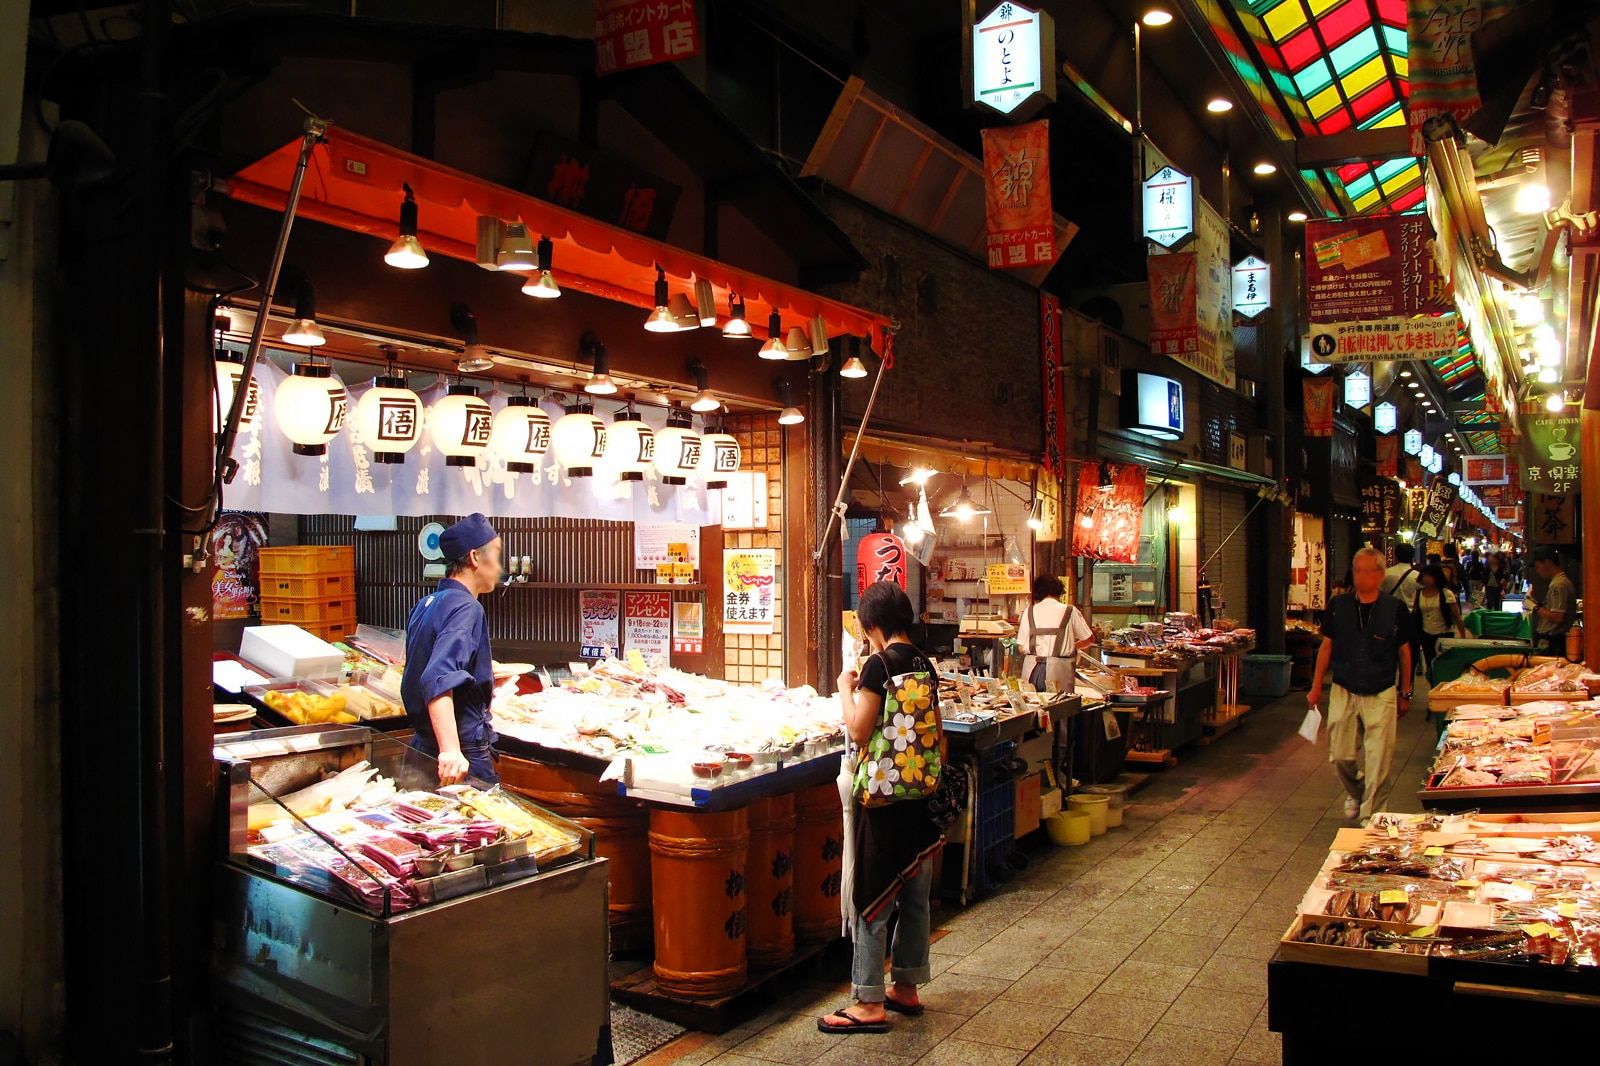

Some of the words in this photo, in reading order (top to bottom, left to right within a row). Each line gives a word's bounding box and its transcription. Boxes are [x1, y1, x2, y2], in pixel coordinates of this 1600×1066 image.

[998, 29, 1014, 85] のとよ
[1410, 221, 1425, 309] ポイントカード
[1337, 328, 1457, 354] 自転車は押して歩きましょう
[1553, 482, 1571, 493] 2F
[628, 594, 669, 604] マンスリー
[726, 592, 750, 605] 金券
[628, 605, 669, 618] プレゼント
[726, 606, 769, 620] 使えます
